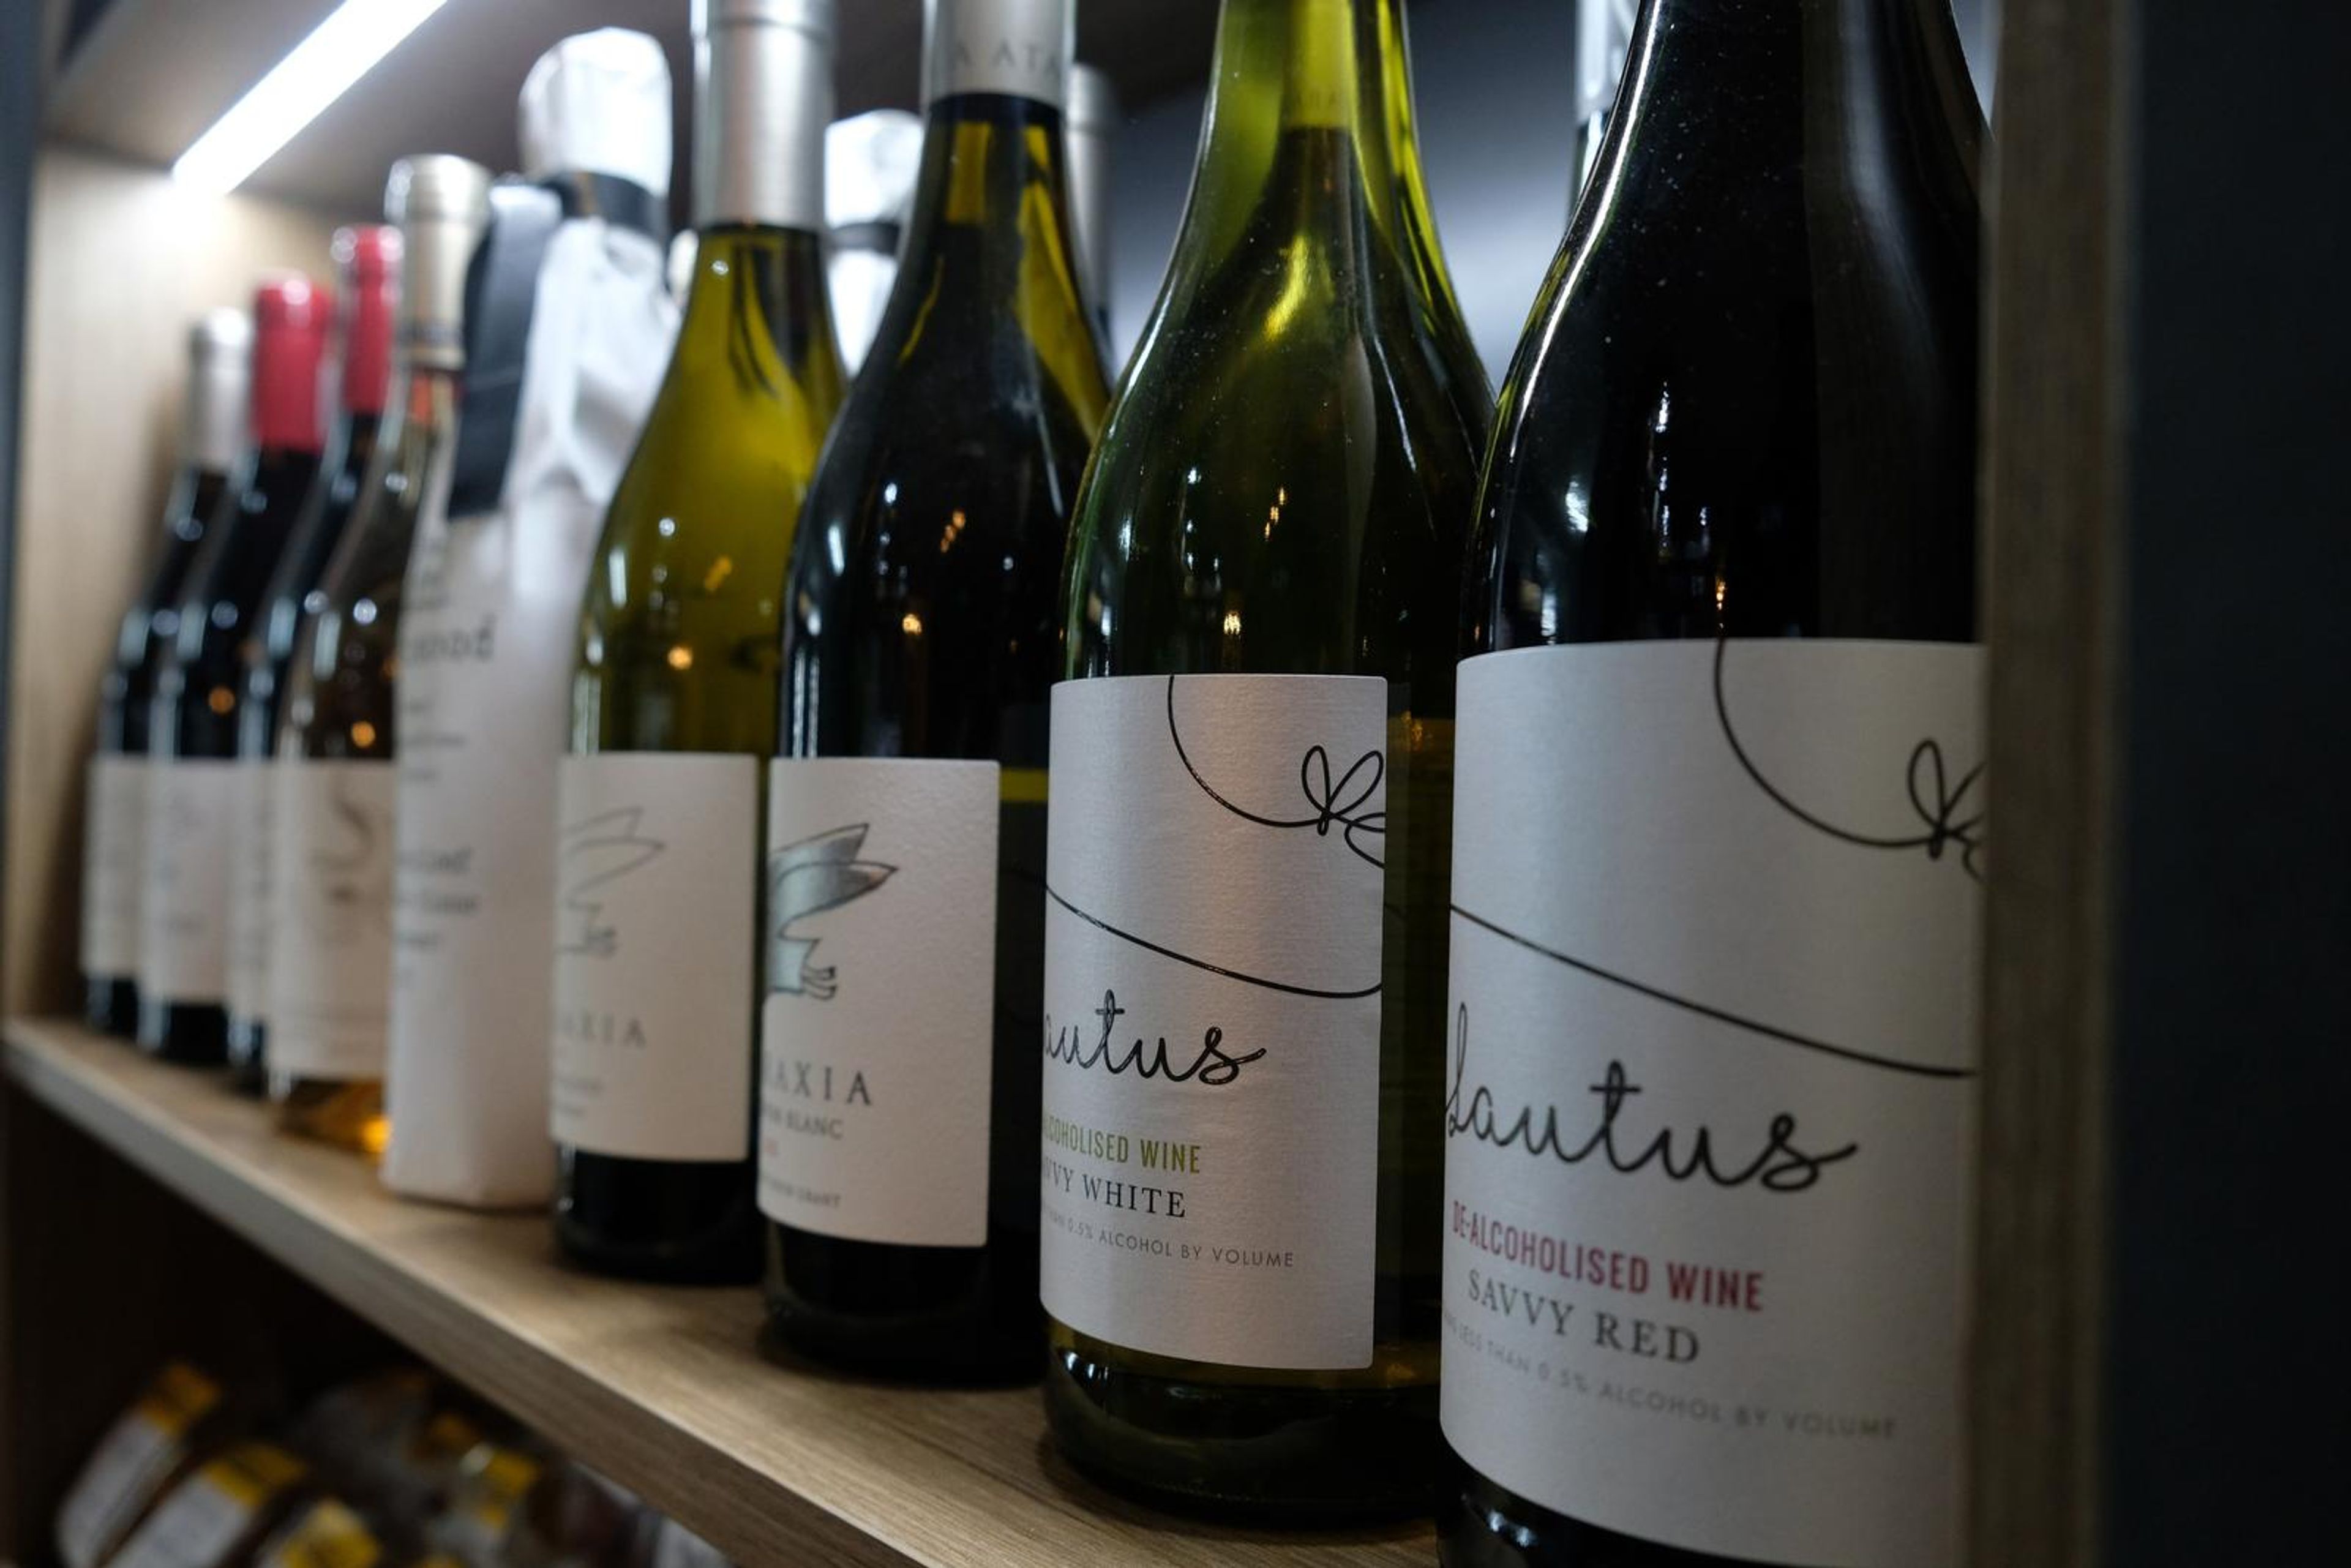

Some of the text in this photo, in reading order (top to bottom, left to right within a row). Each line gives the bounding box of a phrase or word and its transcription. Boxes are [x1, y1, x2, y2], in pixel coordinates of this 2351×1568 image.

[1445, 1002, 1858, 1193] Lautus
[1082, 1174, 1186, 1218] WHITE
[1139, 1139, 1201, 1175] WINE
[1098, 1228, 1172, 1258] ALCOHOL
[1180, 1244, 1202, 1259] BY
[1212, 1247, 1294, 1268] VOLUME
[1452, 1199, 1764, 1313] DE-ALCOHOLISED WINE
[1468, 1269, 1701, 1365] SAVVY RED
[1537, 1362, 1589, 1394] 05%
[1598, 1381, 1722, 1424] ALCOHOL
[1734, 1407, 1768, 1428] BY
[1783, 1412, 1897, 1440] VOLUME
